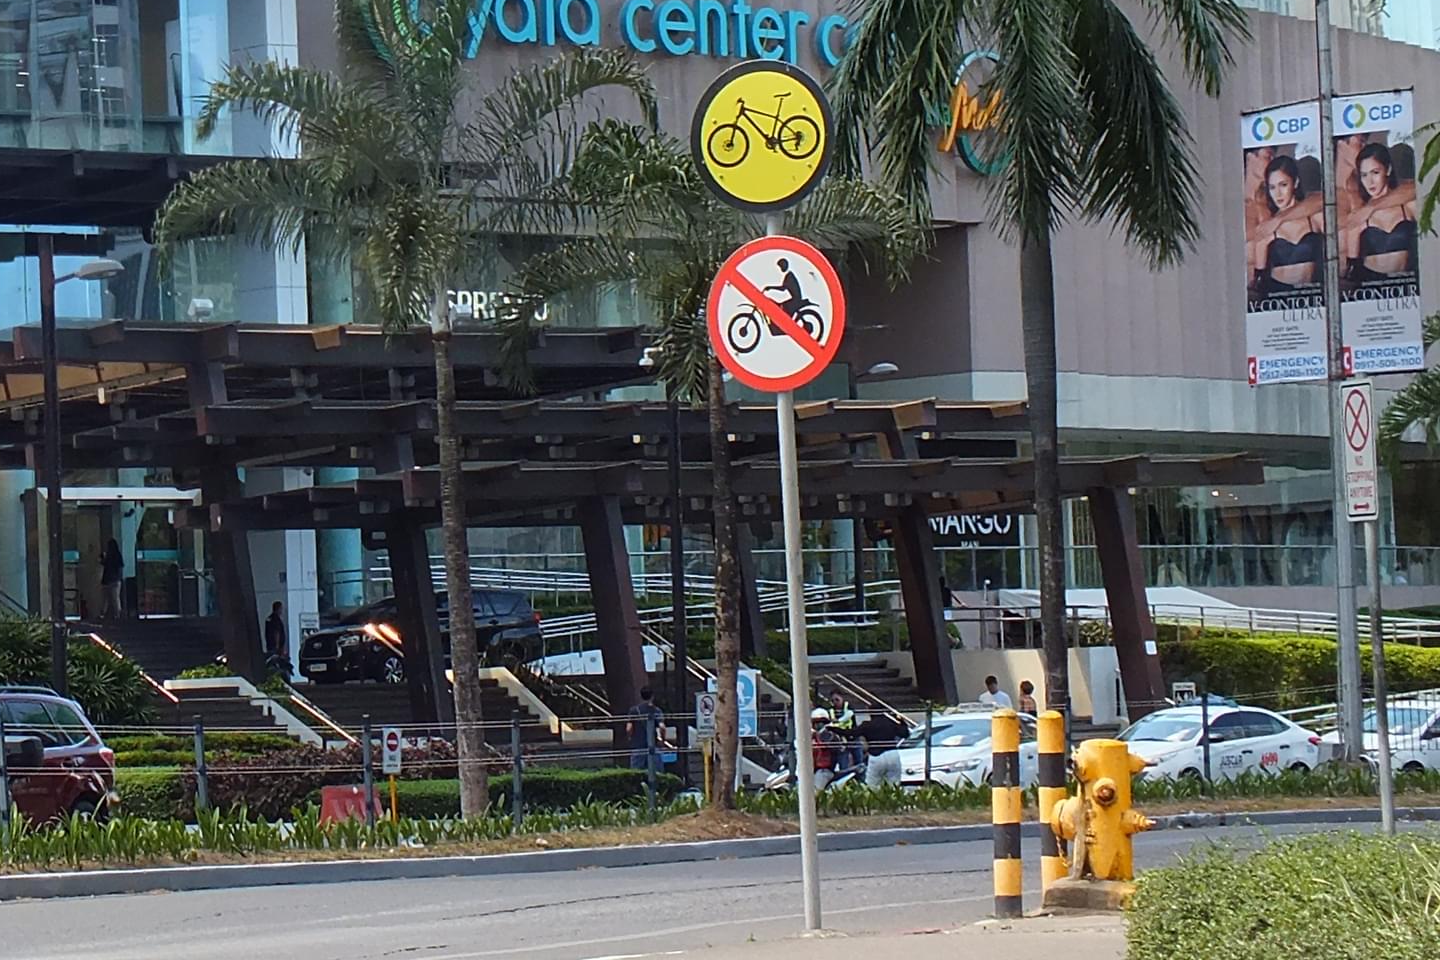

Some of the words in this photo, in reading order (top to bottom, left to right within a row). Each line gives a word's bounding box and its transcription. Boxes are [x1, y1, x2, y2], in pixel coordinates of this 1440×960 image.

[1368, 103, 1403, 121] CBP
[1277, 117, 1310, 134] CBP
[1342, 284, 1418, 303] V-CONTOUR
[1249, 295, 1324, 314] V-CONTOUR
[1376, 296, 1419, 313] ULTRA
[1282, 307, 1324, 323] ULTRA
[1354, 345, 1421, 360] EMERGENCY
[1259, 355, 1325, 370] EMERGENCY
[929, 514, 1012, 535] MANGO
